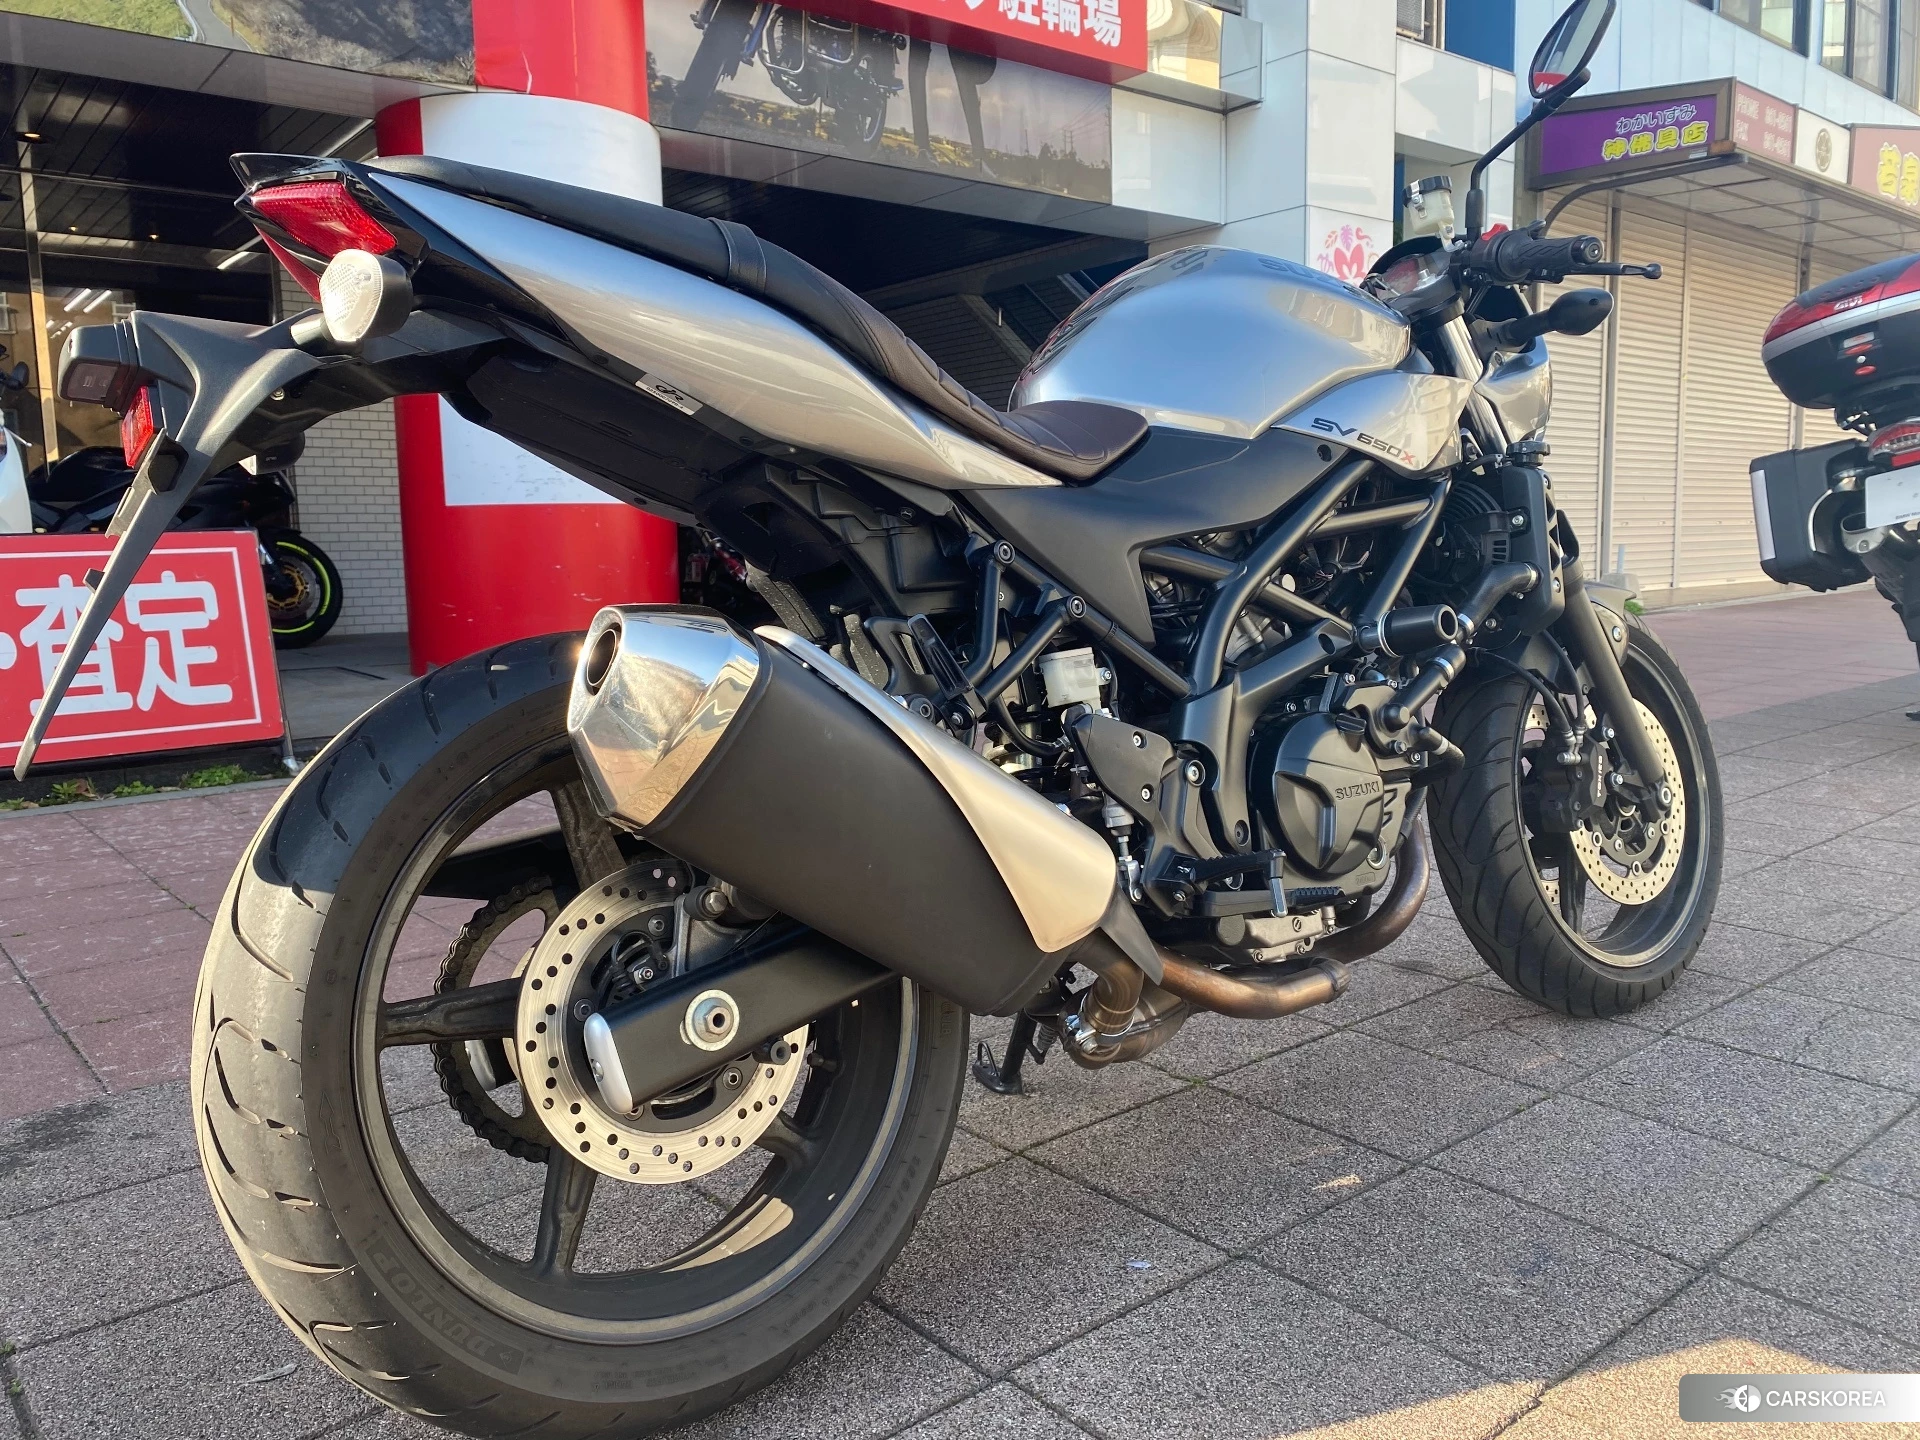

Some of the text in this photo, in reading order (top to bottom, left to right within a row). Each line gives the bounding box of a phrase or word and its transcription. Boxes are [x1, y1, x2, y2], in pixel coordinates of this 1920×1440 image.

[965, 0, 1121, 47] 駐輪場
[0, 570, 233, 717] 査定
[1334, 780, 1380, 801] SUZUKI
[373, 1251, 496, 1357] DUNLOP
